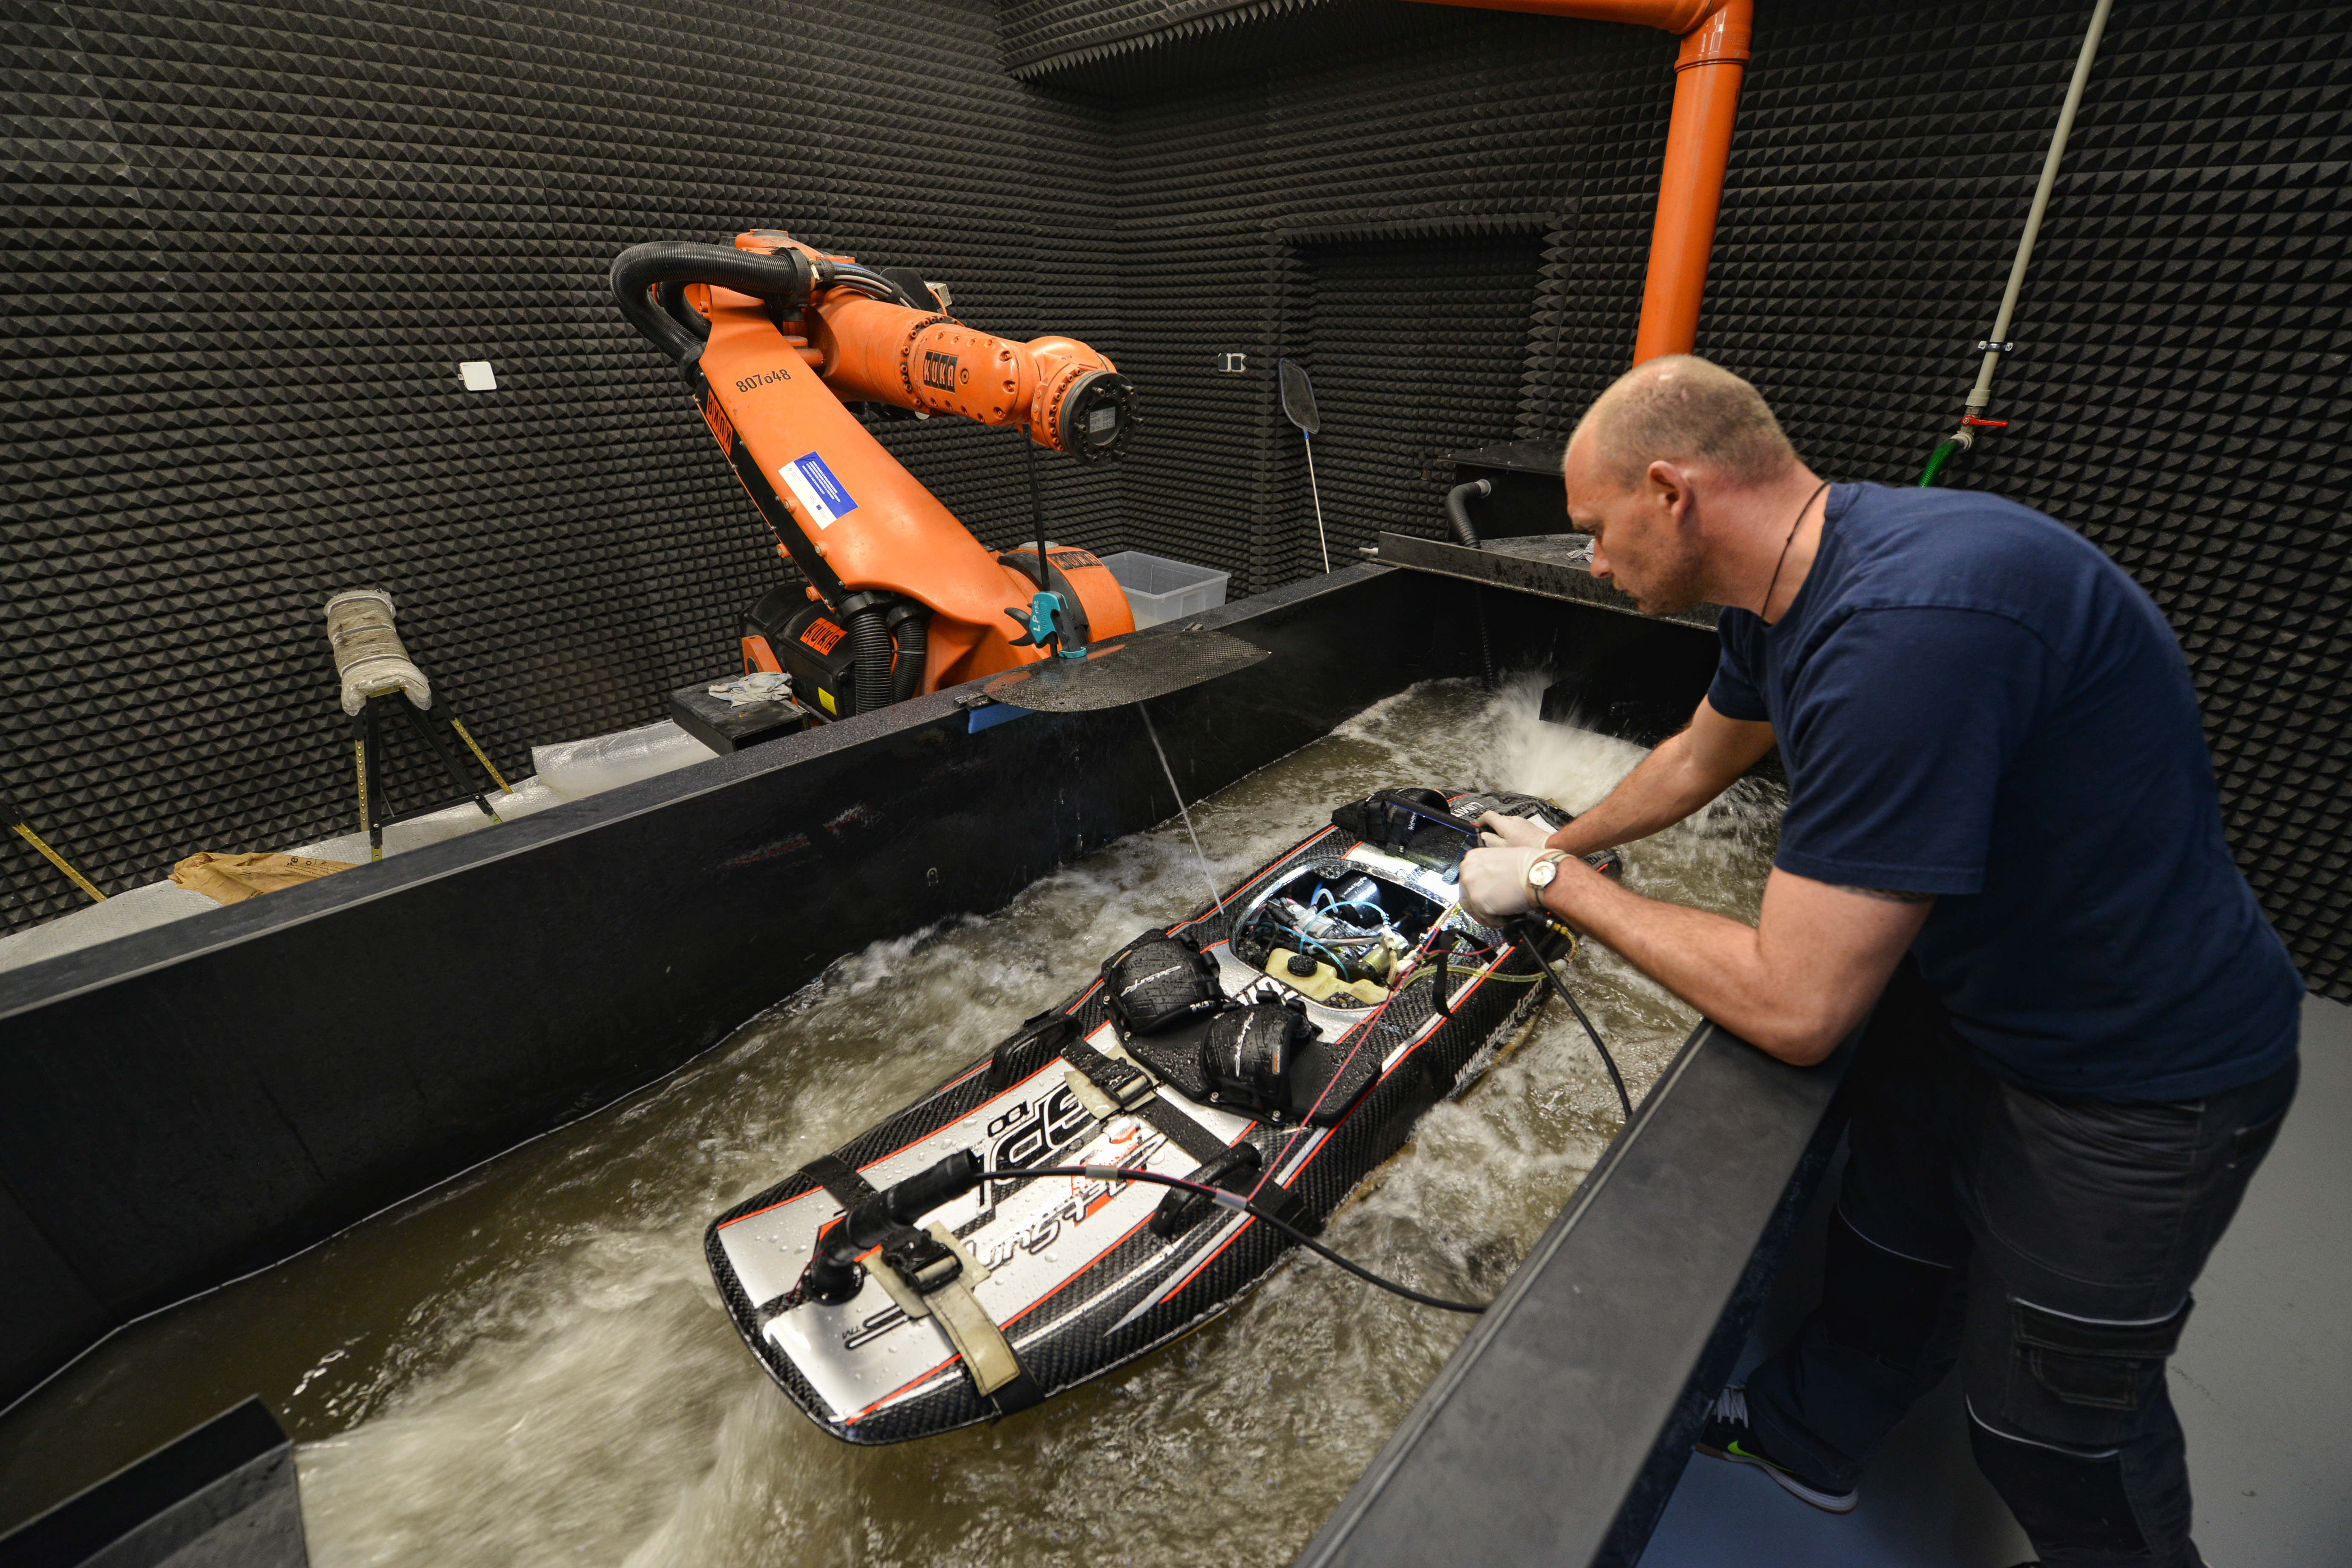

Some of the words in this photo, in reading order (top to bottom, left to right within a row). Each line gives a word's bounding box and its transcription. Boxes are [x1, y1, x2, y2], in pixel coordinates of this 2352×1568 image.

[924, 359, 954, 387] KUKA
[708, 394, 732, 448] KUKA
[1052, 553, 1101, 568] KUKA
[803, 622, 840, 651] KUKA
[987, 1100, 1031, 1138] 100
